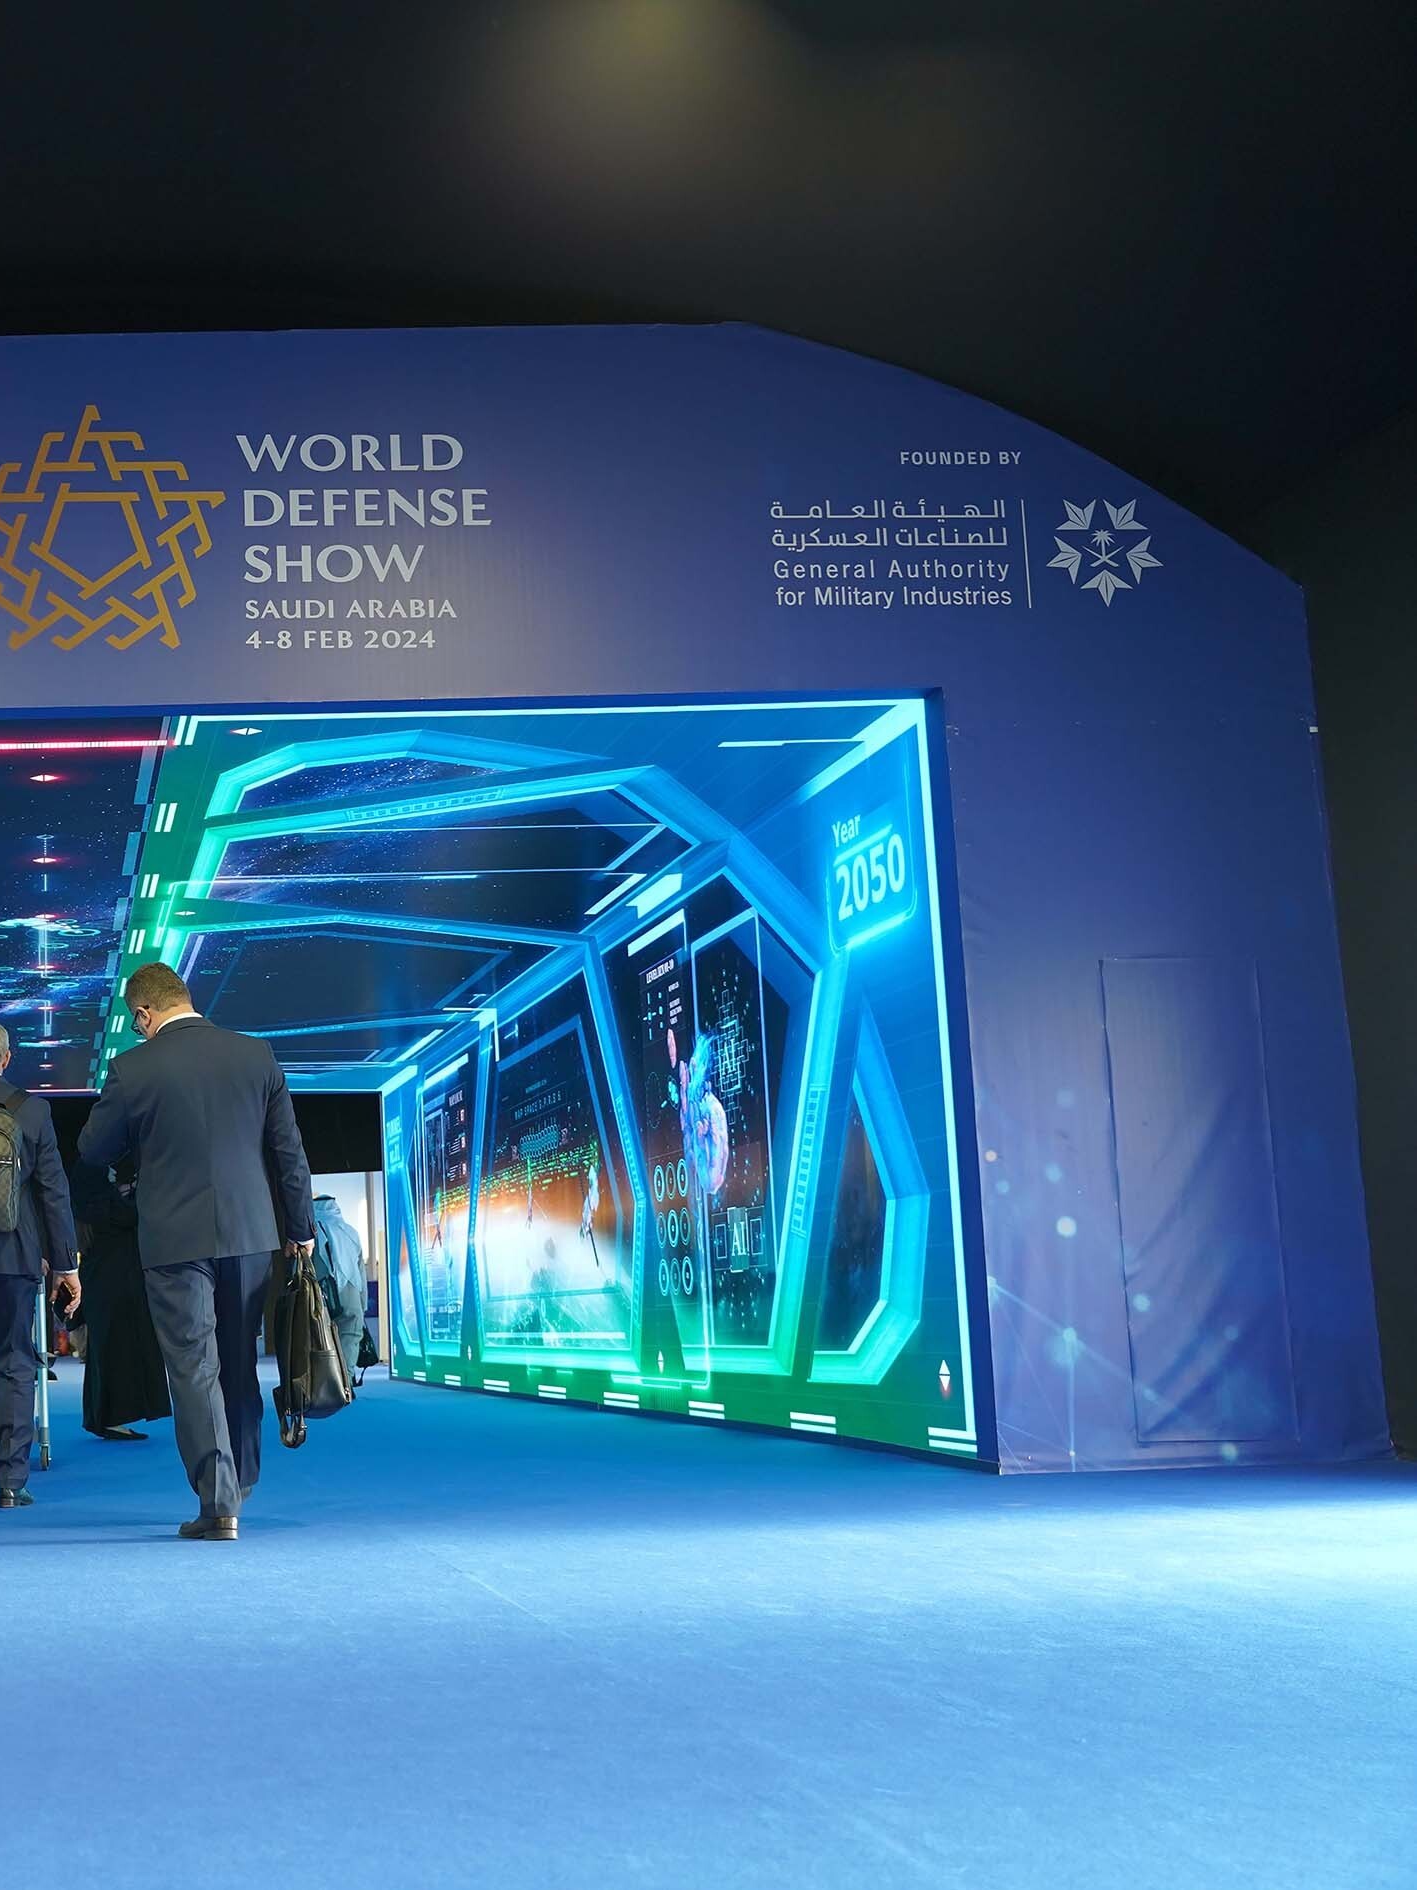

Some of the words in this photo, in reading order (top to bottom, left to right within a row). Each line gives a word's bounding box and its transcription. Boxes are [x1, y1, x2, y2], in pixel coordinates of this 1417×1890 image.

[235, 433, 464, 473] WORLD
[900, 451, 991, 465] FOUNDED
[998, 451, 1022, 465] BY
[243, 488, 492, 529] DEFENSE
[770, 499, 886, 519] العامة
[892, 498, 1006, 523] الهيئة
[771, 527, 888, 553] العسكرية
[895, 527, 1008, 546] للصناعات
[243, 543, 425, 584] SHOW
[773, 559, 875, 579] General
[888, 559, 1009, 582] Authority
[245, 599, 335, 620] SAUDI
[345, 599, 458, 619] ARABIA
[775, 586, 806, 606] for
[814, 585, 895, 610] Military
[903, 585, 1012, 606] Industries
[245, 630, 293, 649] 4-8
[304, 630, 354, 649] FEB
[364, 629, 436, 649] 2024
[832, 814, 861, 848] Year
[836, 833, 906, 920] 2050
